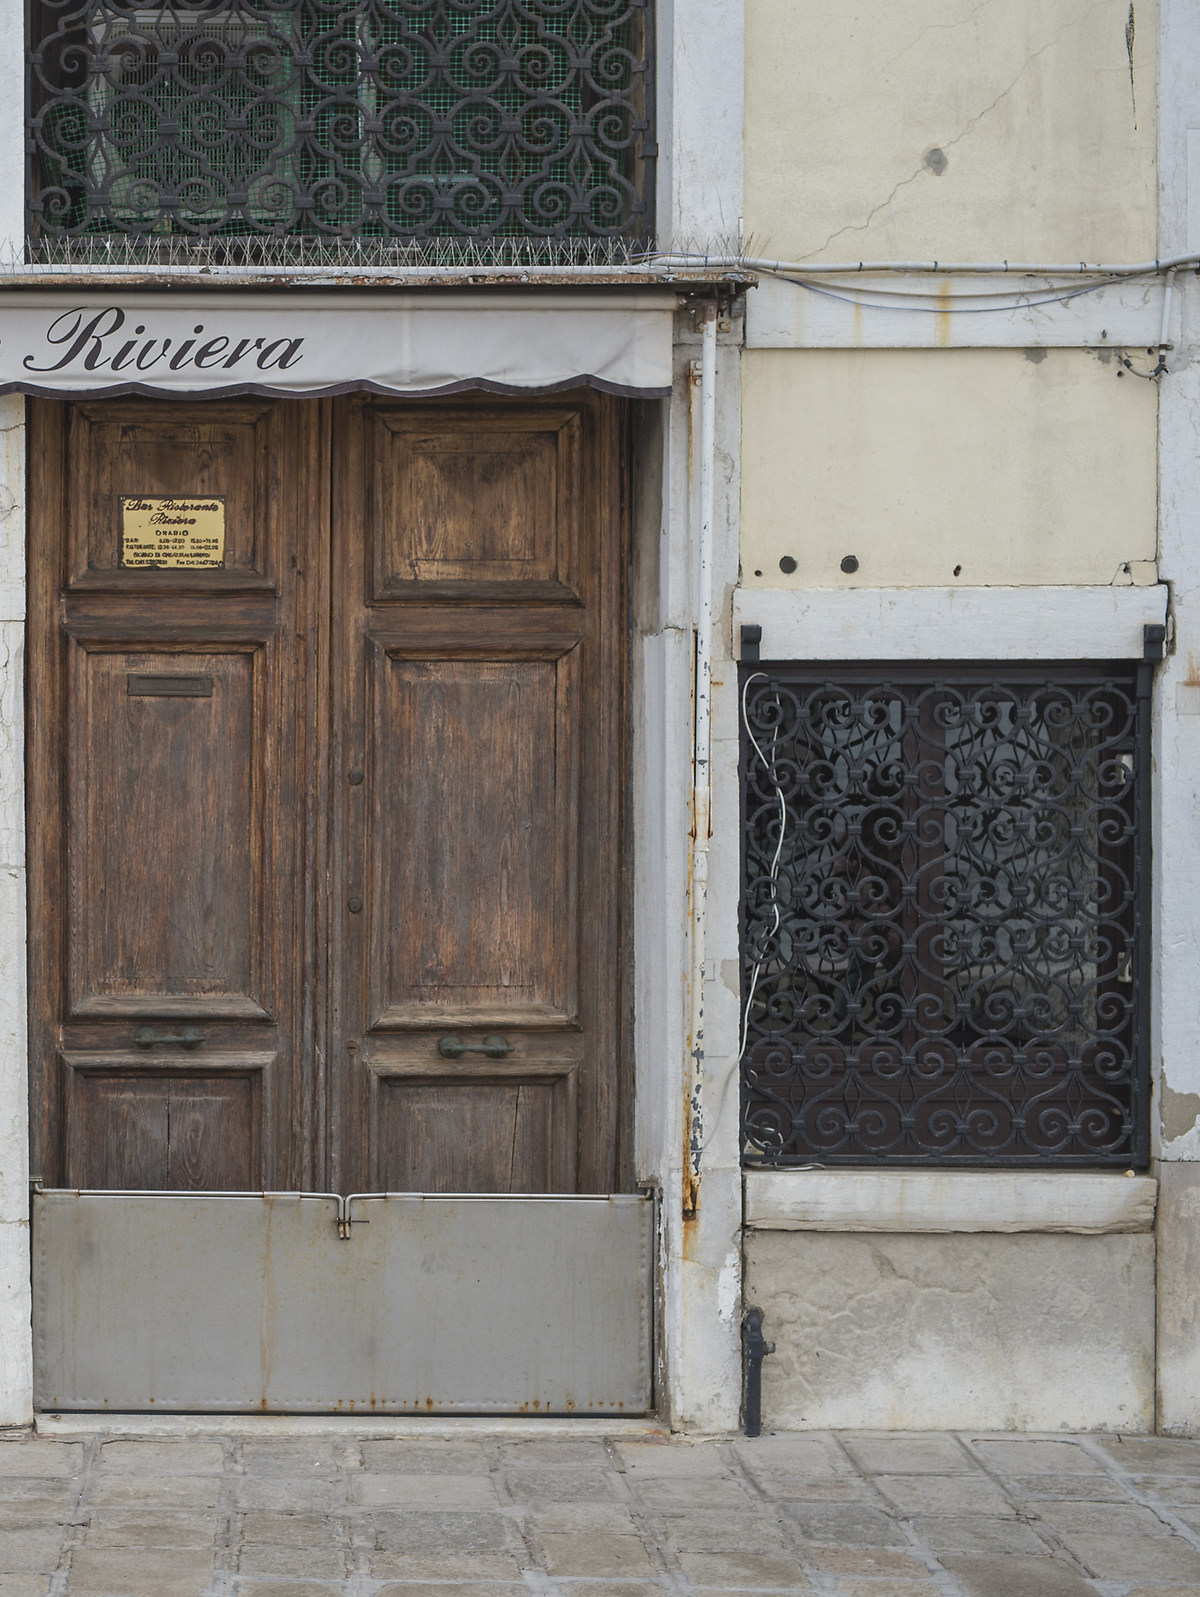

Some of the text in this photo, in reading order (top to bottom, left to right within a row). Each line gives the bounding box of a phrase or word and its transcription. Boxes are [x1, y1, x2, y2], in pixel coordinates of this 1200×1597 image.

[23, 306, 305, 372] Riviera
[126, 499, 219, 511] Bar Ristorante
[150, 512, 197, 525] Riviera
